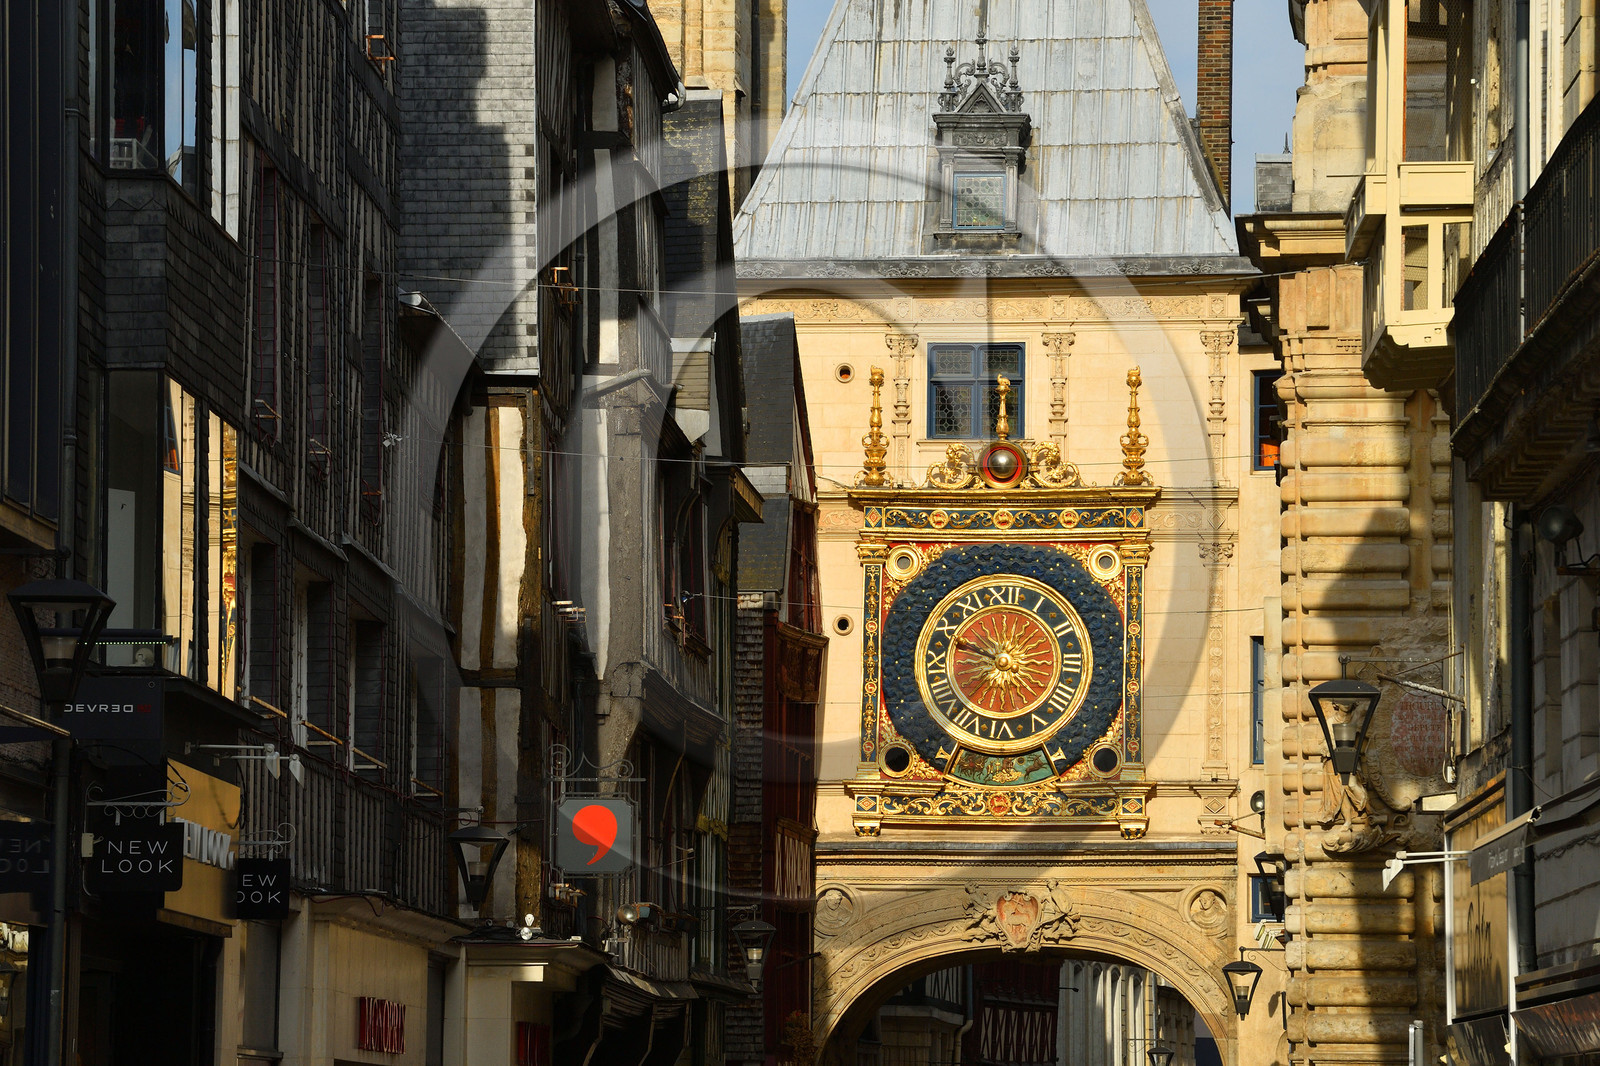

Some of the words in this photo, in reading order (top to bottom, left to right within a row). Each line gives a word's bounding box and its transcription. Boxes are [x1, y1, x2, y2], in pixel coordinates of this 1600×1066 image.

[955, 592, 984, 619] XI
[988, 587, 1020, 605] XII
[1032, 595, 1045, 613] I
[935, 617, 958, 640] X
[1053, 620, 1073, 638] II
[927, 650, 946, 675] IX
[1062, 653, 1081, 673] III
[930, 678, 957, 716] VIII
[1048, 682, 1075, 712] IIII
[953, 707, 980, 736] VII
[989, 720, 1015, 739] VI
[1032, 713, 1048, 733] V
[107, 840, 168, 855] NEW
[101, 859, 173, 874] LOOK
[242, 874, 277, 887] EW
